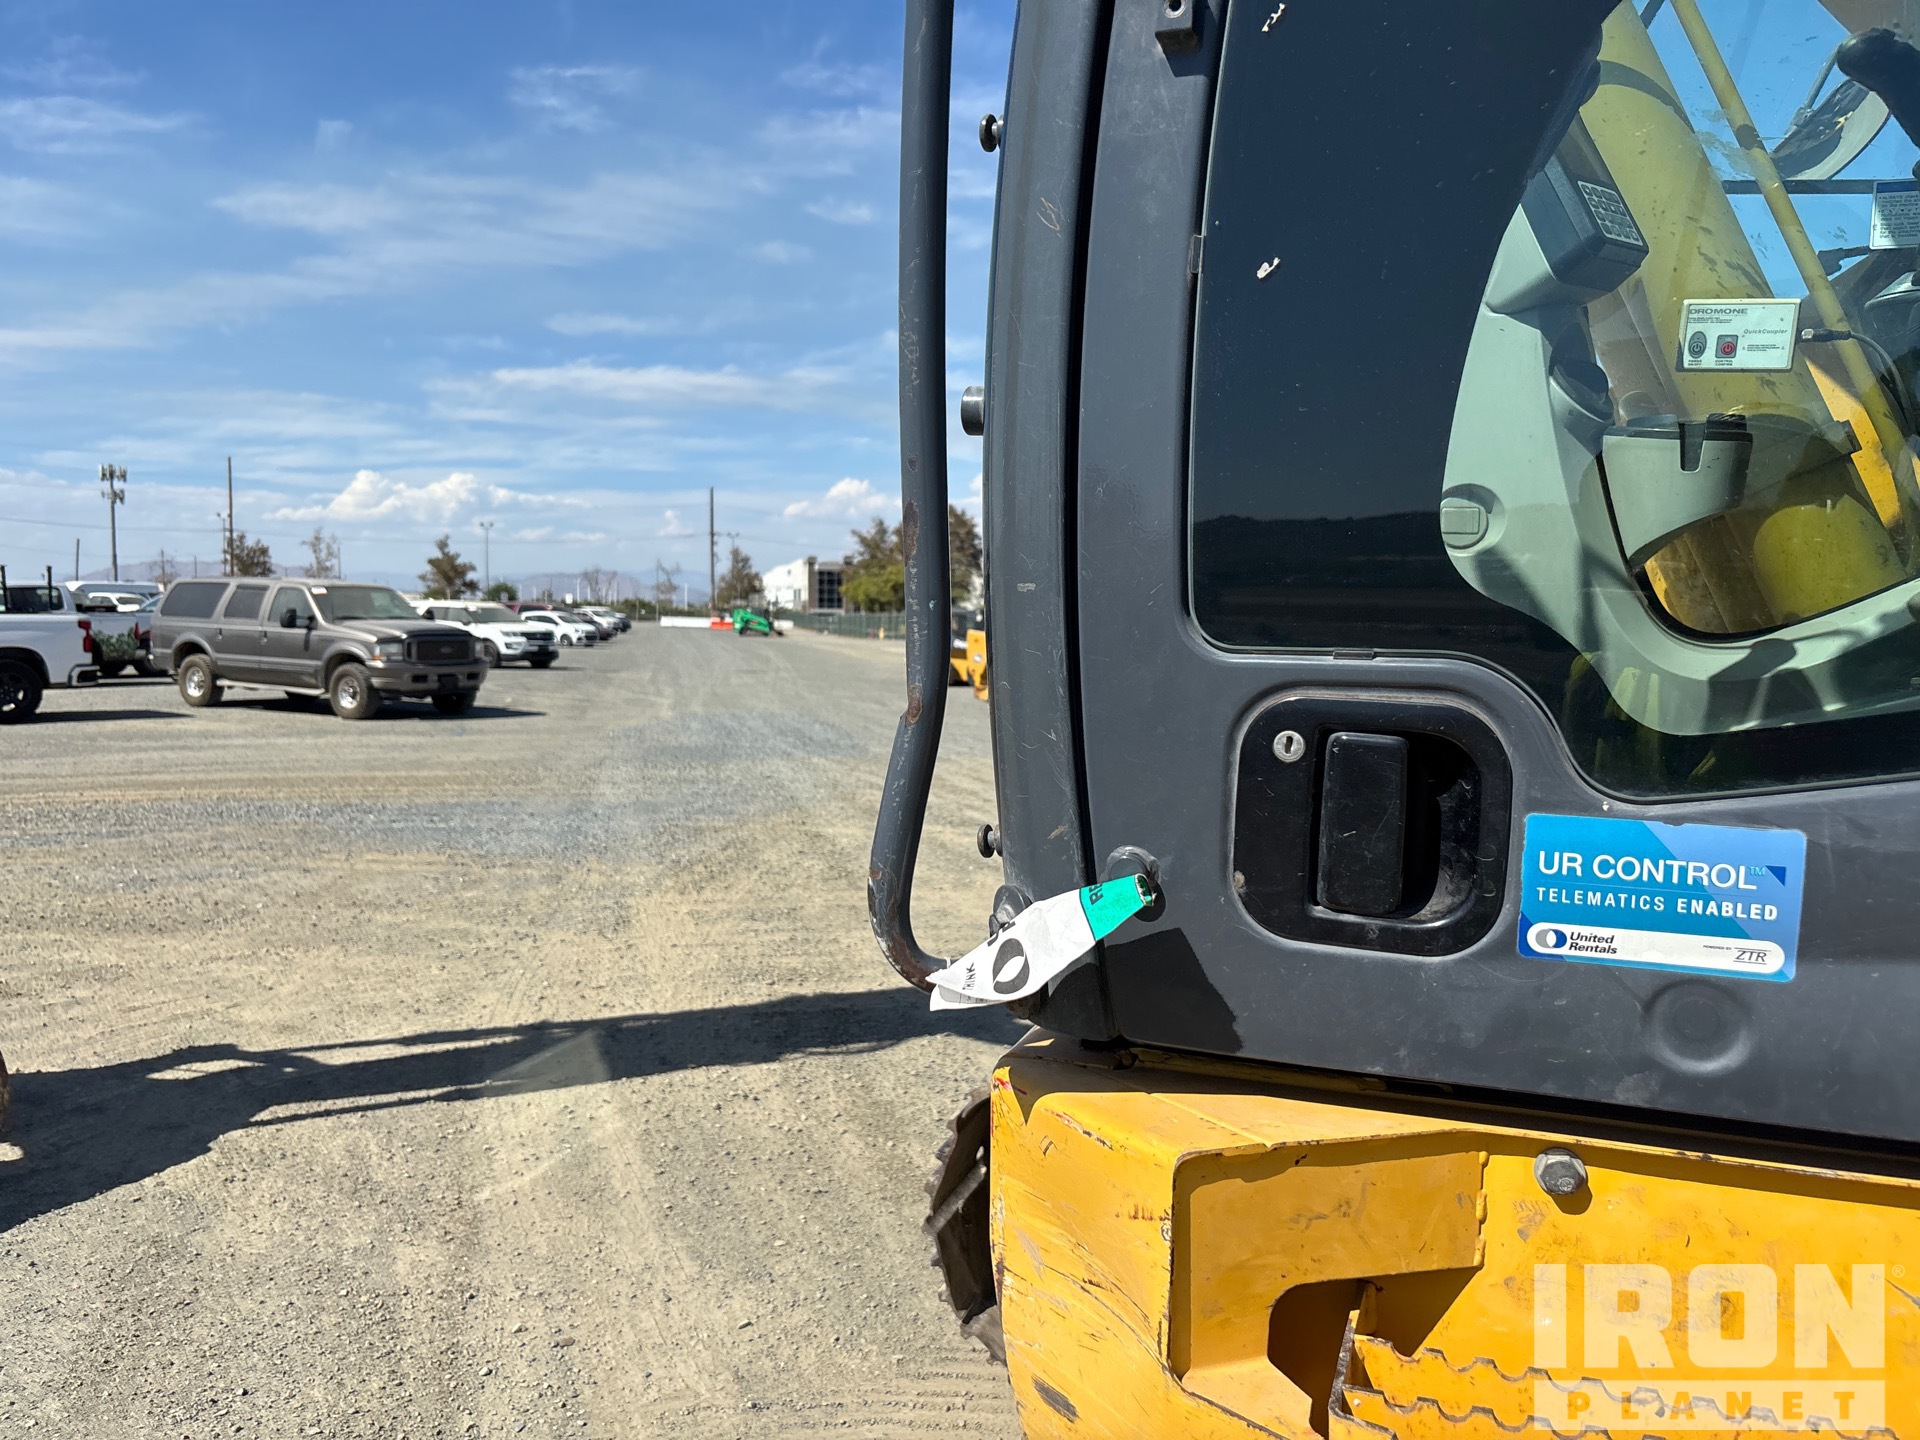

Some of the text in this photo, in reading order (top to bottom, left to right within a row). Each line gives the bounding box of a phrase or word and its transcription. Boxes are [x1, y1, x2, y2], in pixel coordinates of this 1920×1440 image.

[1538, 850, 1583, 877] UR
[1536, 887, 1779, 921] TELEMATICS ENABLED
[1569, 931, 1614, 944] United
[1569, 942, 1618, 955] Rentals
[1734, 949, 1767, 963] ZTR
[962, 962, 976, 991] THINK
